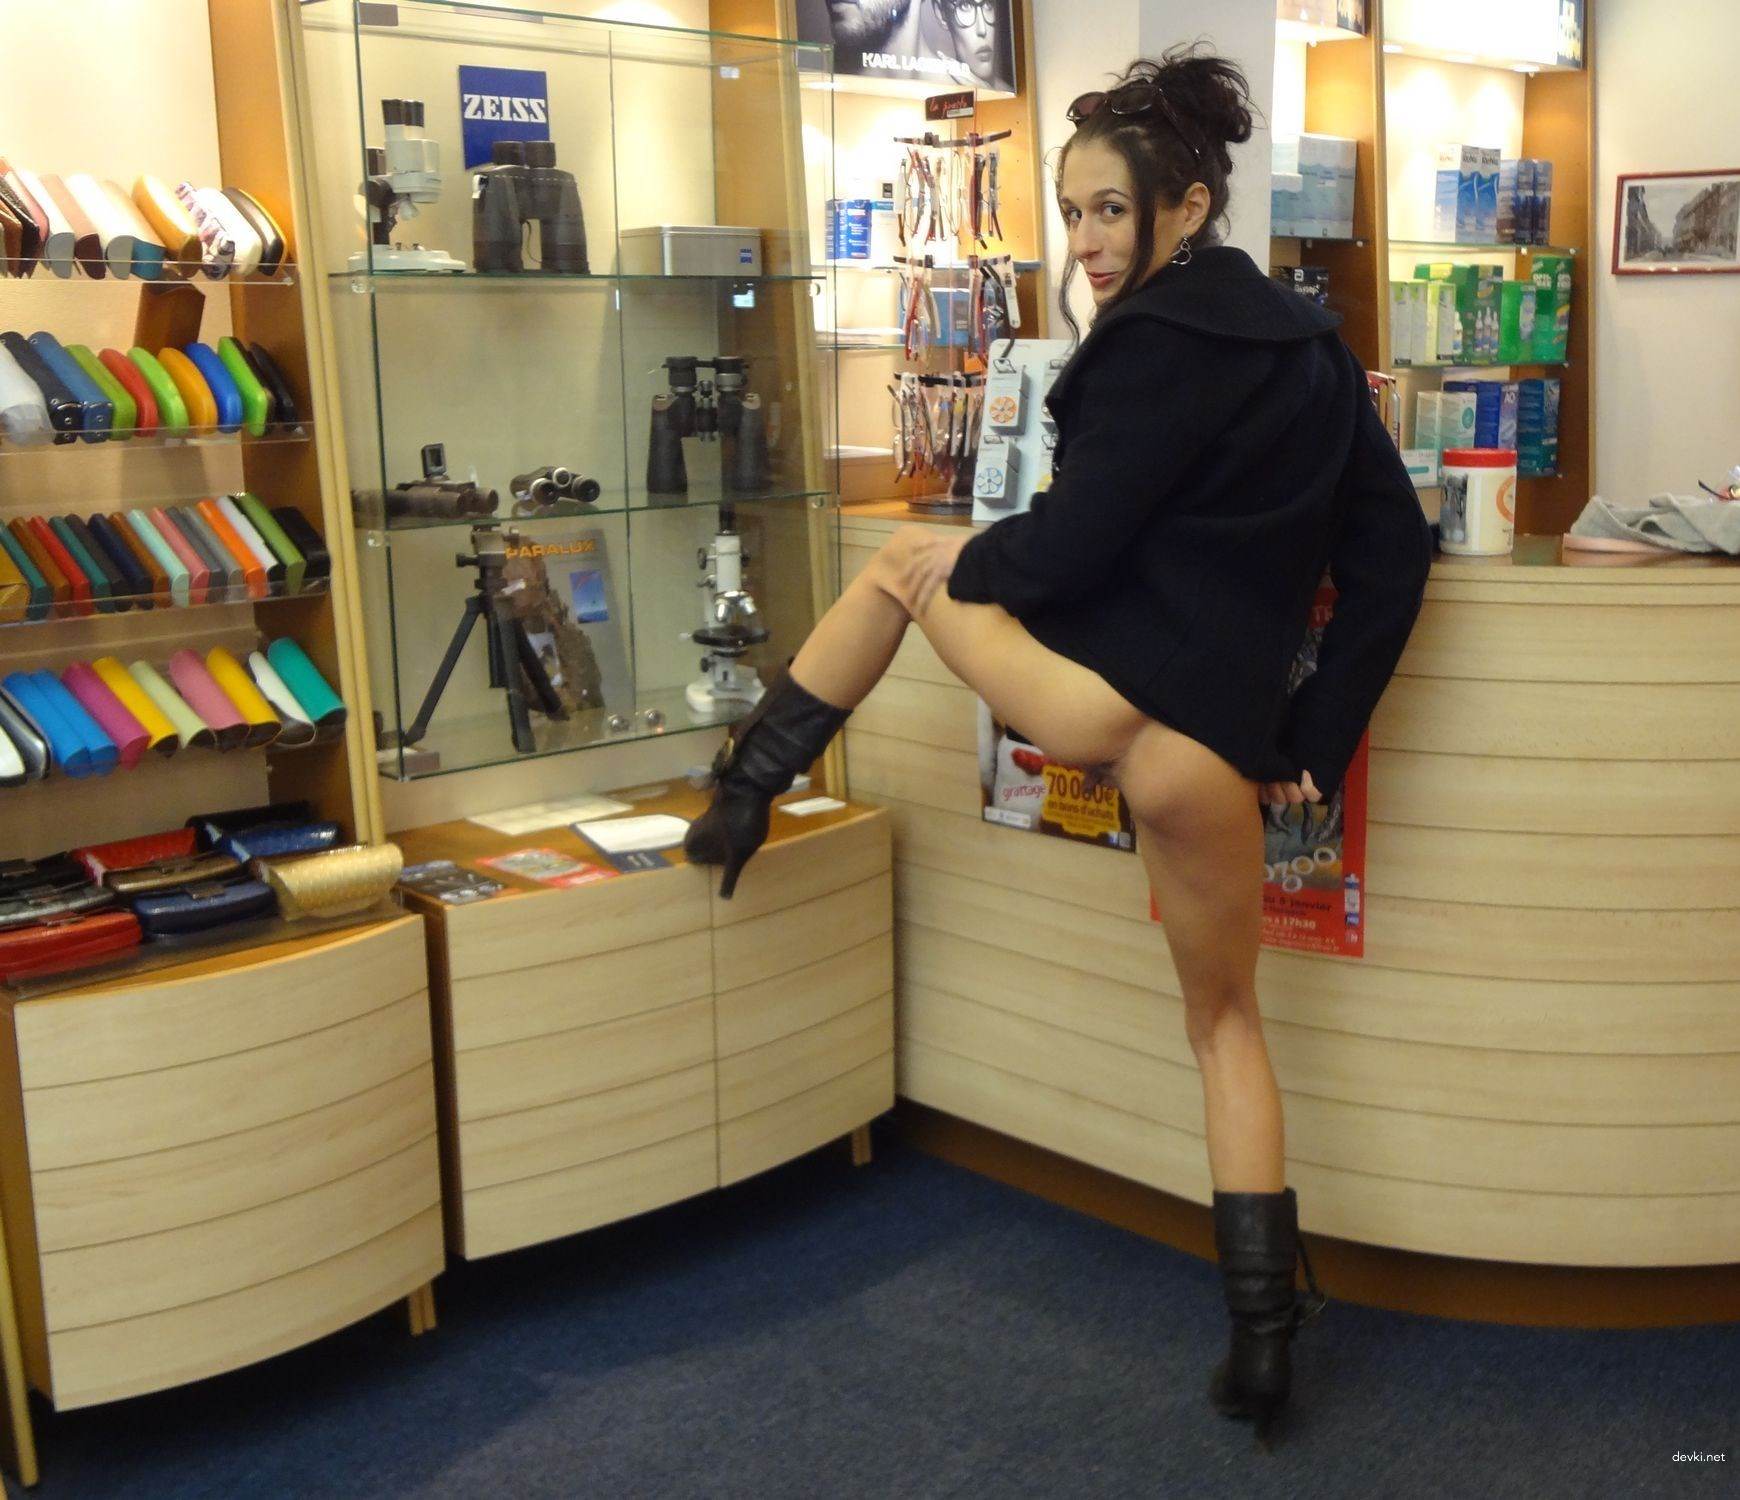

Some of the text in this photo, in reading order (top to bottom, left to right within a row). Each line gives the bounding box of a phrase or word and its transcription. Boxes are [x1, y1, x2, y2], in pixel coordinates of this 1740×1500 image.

[862, 52, 900, 70] KARL
[463, 94, 547, 124] ZEISS
[505, 539, 596, 560] PARALUX
[1002, 784, 1046, 801] grattage
[1283, 917, 1316, 930] 17h30
